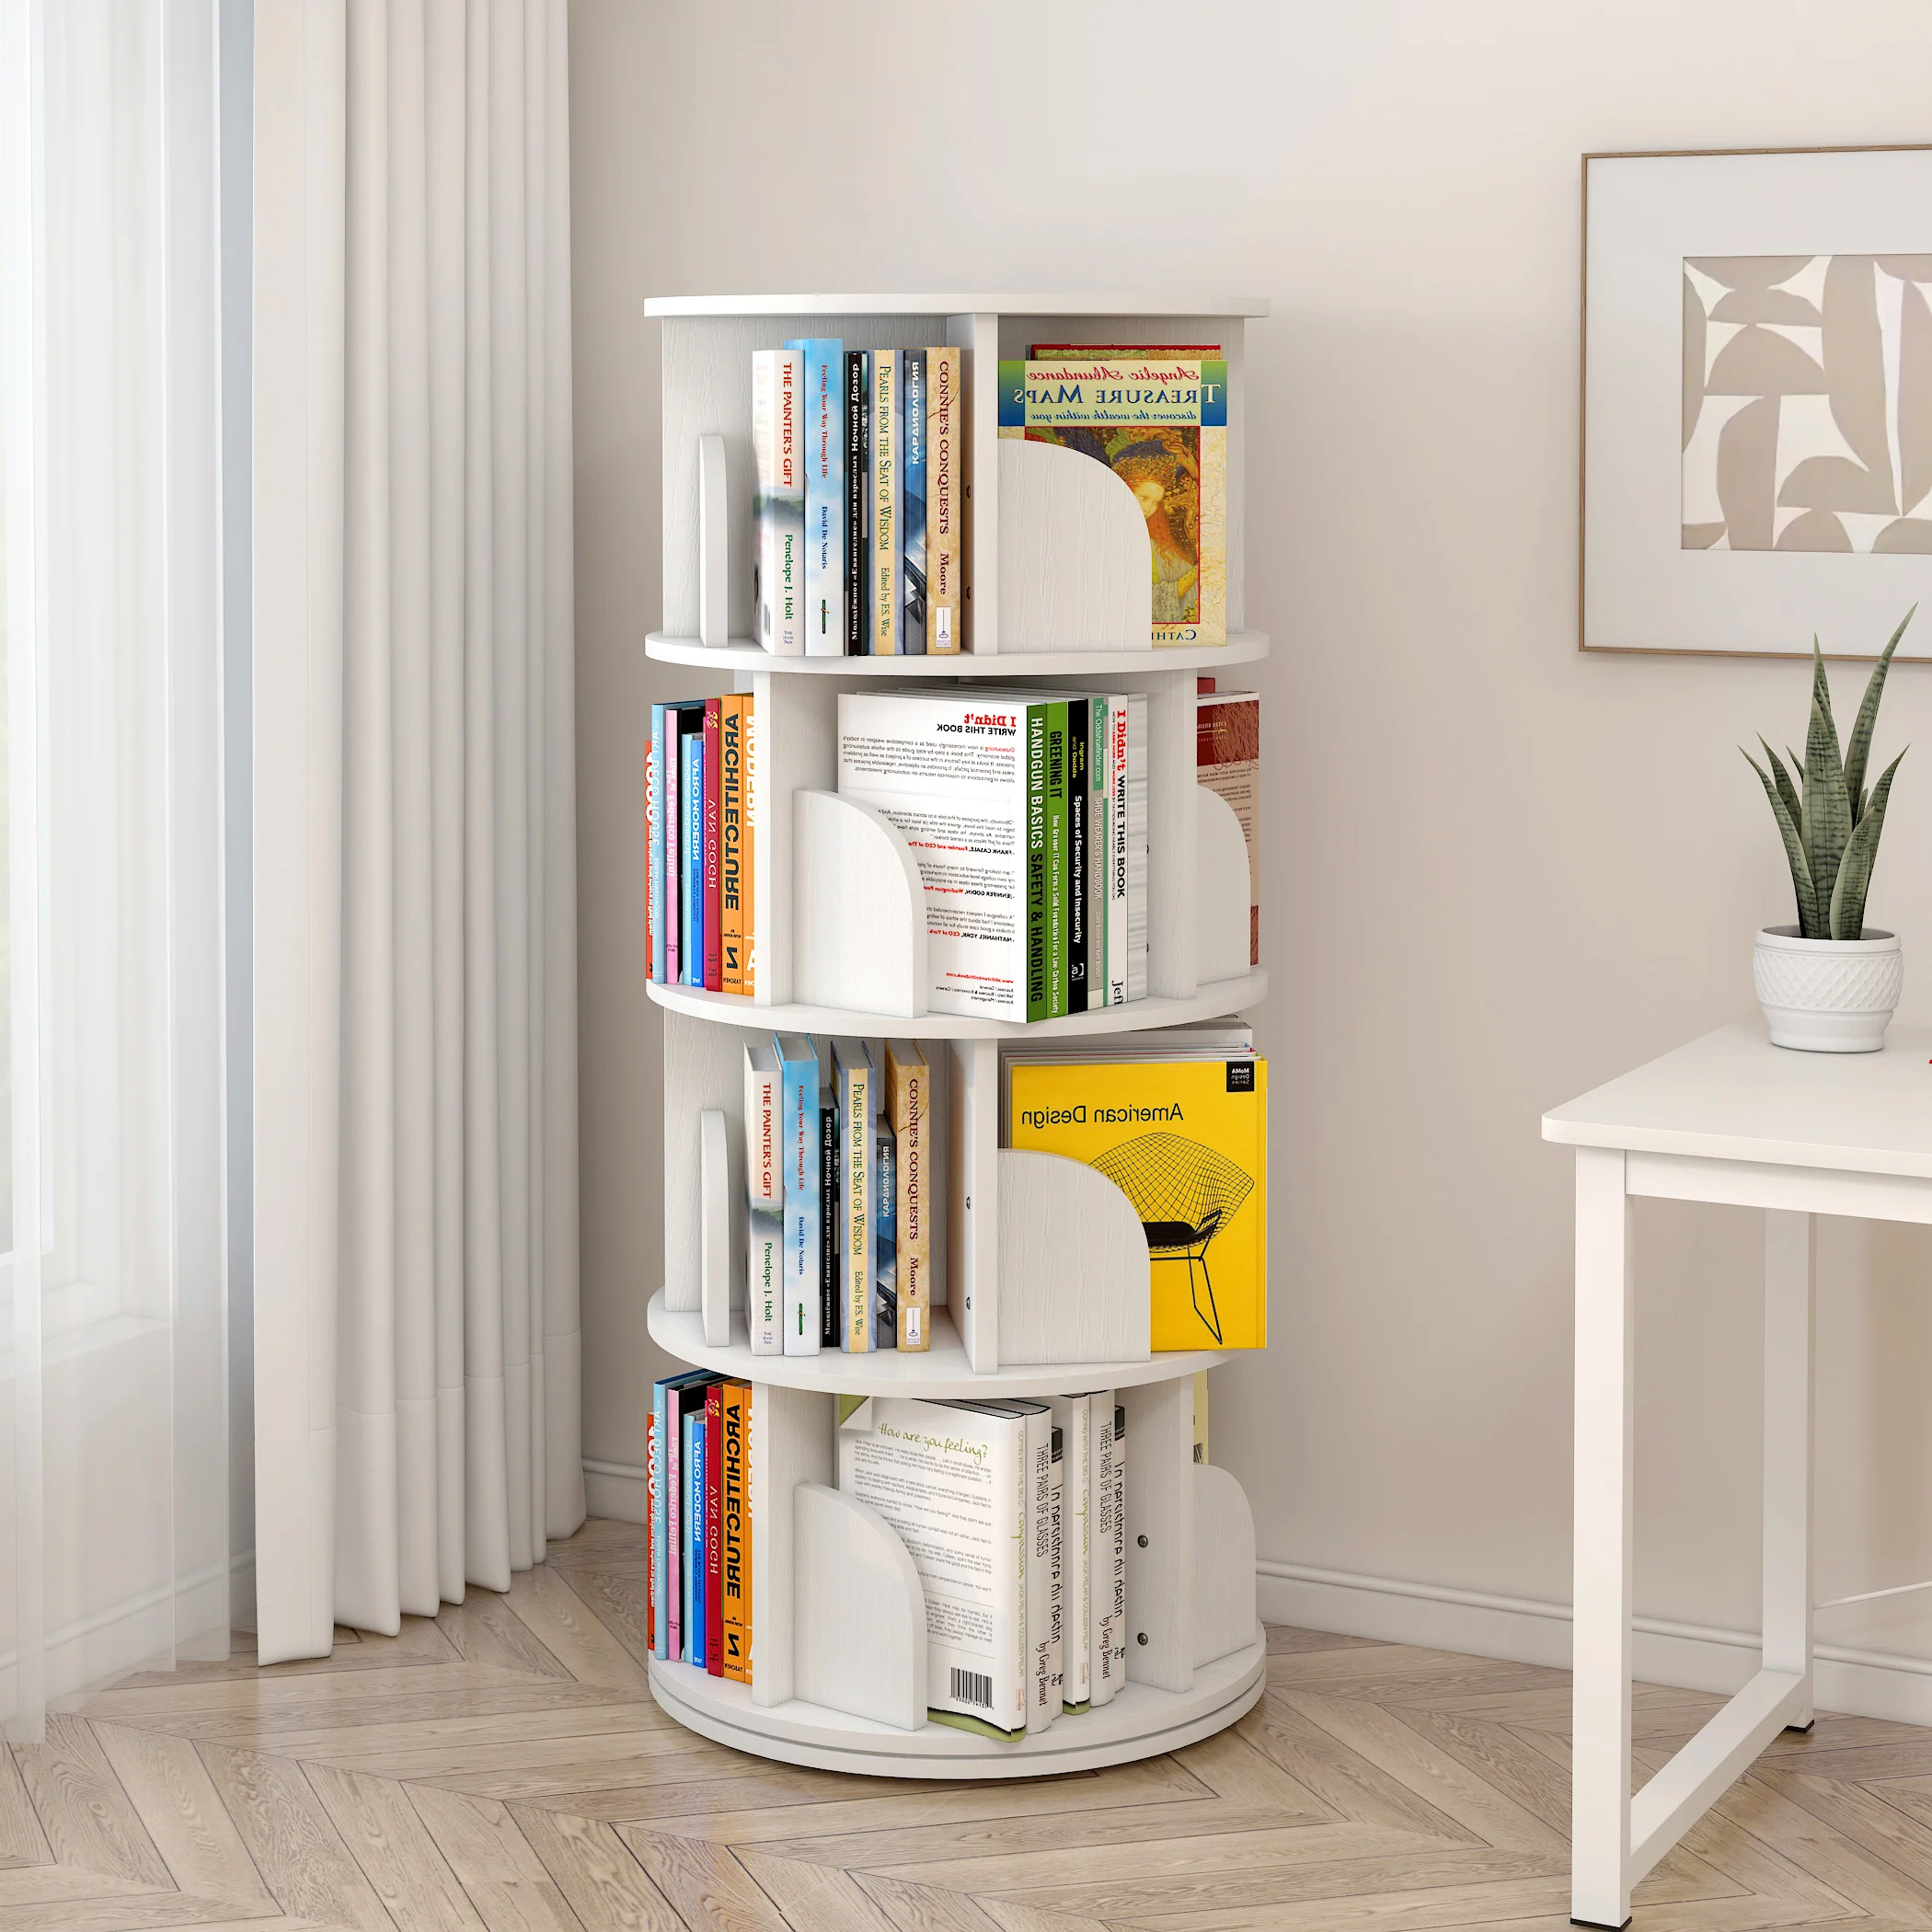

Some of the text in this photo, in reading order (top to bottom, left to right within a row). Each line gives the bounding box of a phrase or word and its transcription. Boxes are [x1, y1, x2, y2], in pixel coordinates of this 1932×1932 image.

[820, 365, 828, 391] Feeling
[784, 362, 792, 487] THE PAINTER'S GIFT
[820, 414, 828, 427] Way
[912, 362, 920, 465] КАРДИОЛОГИЯ
[820, 431, 828, 462] Through
[880, 366, 892, 549] PEARLS FROM THE SEAT OF WISDOM
[937, 361, 950, 534] CONNIE'S CONQUESTS
[784, 535, 794, 582] Penelope
[822, 530, 828, 539] De
[881, 568, 891, 591] Edited
[940, 554, 949, 594] Moore
[786, 598, 794, 619] Holt
[881, 604, 891, 615] F.S.
[881, 619, 891, 636] Wise
[1050, 731, 1063, 798] GREENING IT
[1095, 705, 1103, 782] The Oddshoefinder.com
[1118, 721, 1127, 770] Didn't
[1118, 776, 1126, 818] WRITE
[1031, 718, 1043, 1002] HANDGUN BASICS SAFETY & HANDLING
[1094, 798, 1103, 900] SHOE WEARER'S HANDBOOK
[1118, 822, 1126, 854] THIS
[1074, 796, 1083, 943] Spaces of Security and Insecurity
[1118, 857, 1126, 898] BOOK
[1051, 992, 1060, 1014] Society
[764, 1083, 772, 1198] THE PAINTER'S GIFT
[908, 1078, 919, 1239] CONNIE'S CONQUESTS
[854, 1085, 865, 1255] PEARLS FROM THE SEAT OF WISDOM
[765, 1243, 773, 1287] Penelope
[911, 1258, 919, 1295] Moore
[765, 1301, 773, 1321] Holt
[879, 1423, 988, 1466] How are you feeling?
[1036, 1443, 1049, 1557] THREE PAIRS OF GLASSES
[1100, 1421, 1111, 1533] THREE PAIRS OF GLASSES
[1010, 1512, 1026, 1580] Compassion
[1075, 1489, 1090, 1556] Compassion
[1099, 1615, 1112, 1679] by Greg Bennet
[1036, 1641, 1050, 1706] by Greg Bennet
